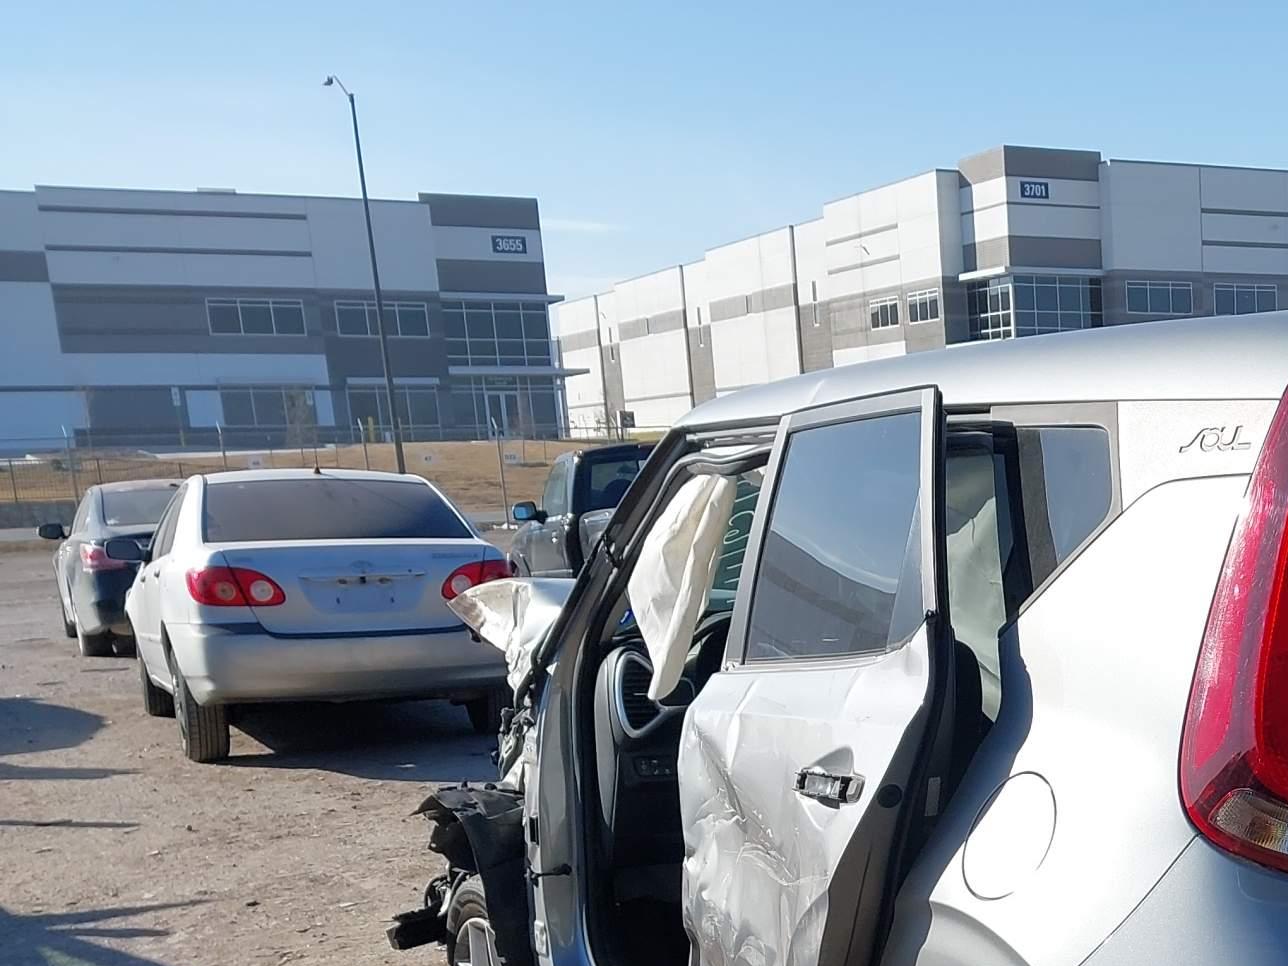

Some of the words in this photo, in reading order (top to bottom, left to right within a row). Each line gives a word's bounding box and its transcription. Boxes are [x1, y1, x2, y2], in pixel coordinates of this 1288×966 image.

[1024, 184, 1046, 197] 3701
[495, 238, 523, 252] 3655
[1179, 425, 1251, 453] SOUL
